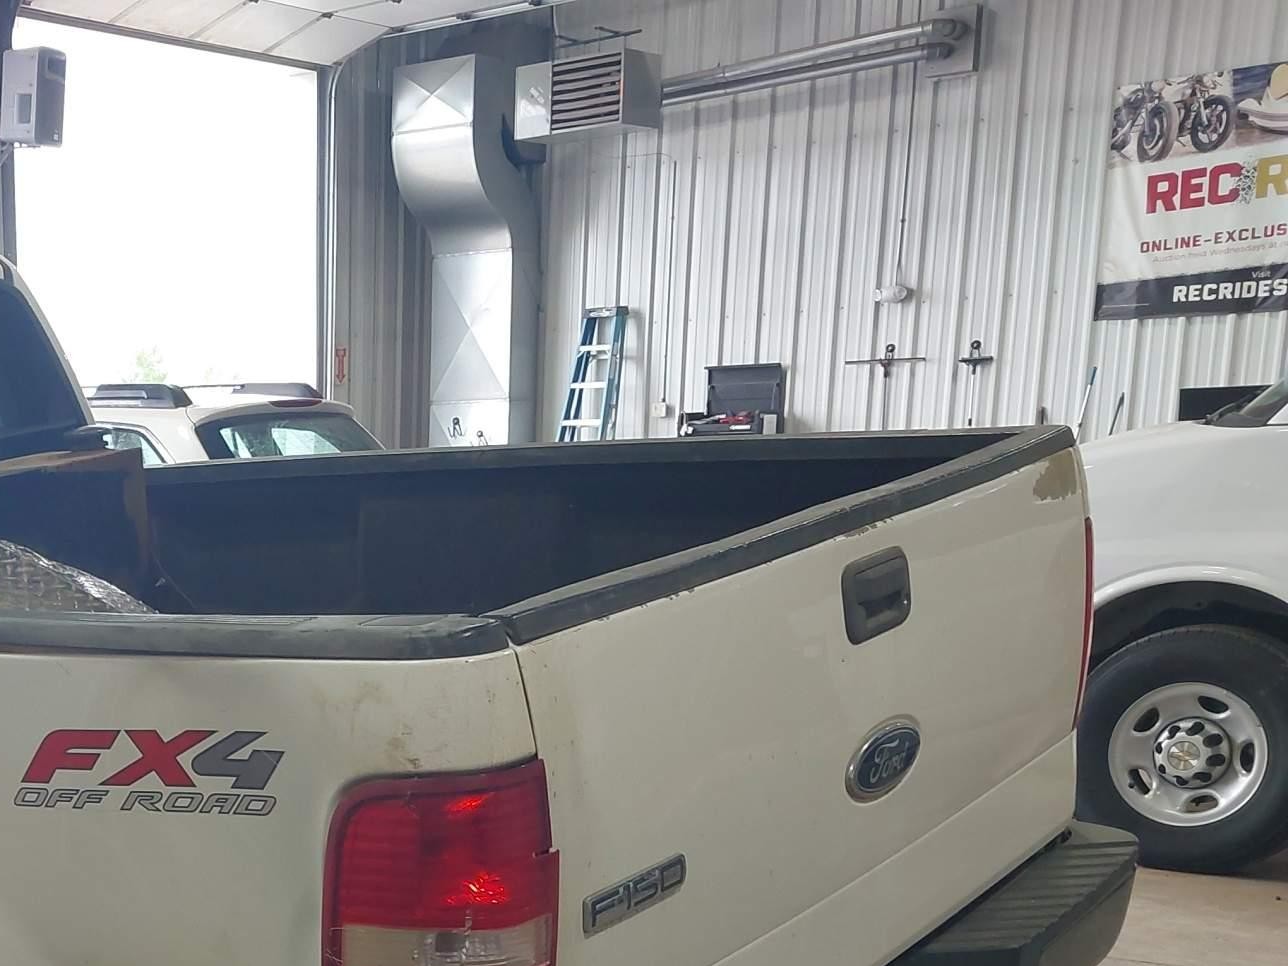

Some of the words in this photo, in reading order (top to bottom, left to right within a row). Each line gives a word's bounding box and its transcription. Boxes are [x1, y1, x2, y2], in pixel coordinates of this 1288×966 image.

[1145, 162, 1244, 215] REC
[1139, 223, 1288, 254] ONLINE-EXCLUS
[1172, 278, 1288, 303] RECRIDES
[1251, 270, 1272, 280] Visit
[21, 729, 285, 791] FX4
[869, 738, 911, 784] Ford
[13, 787, 110, 809] OFF
[119, 790, 278, 817] ROAD
